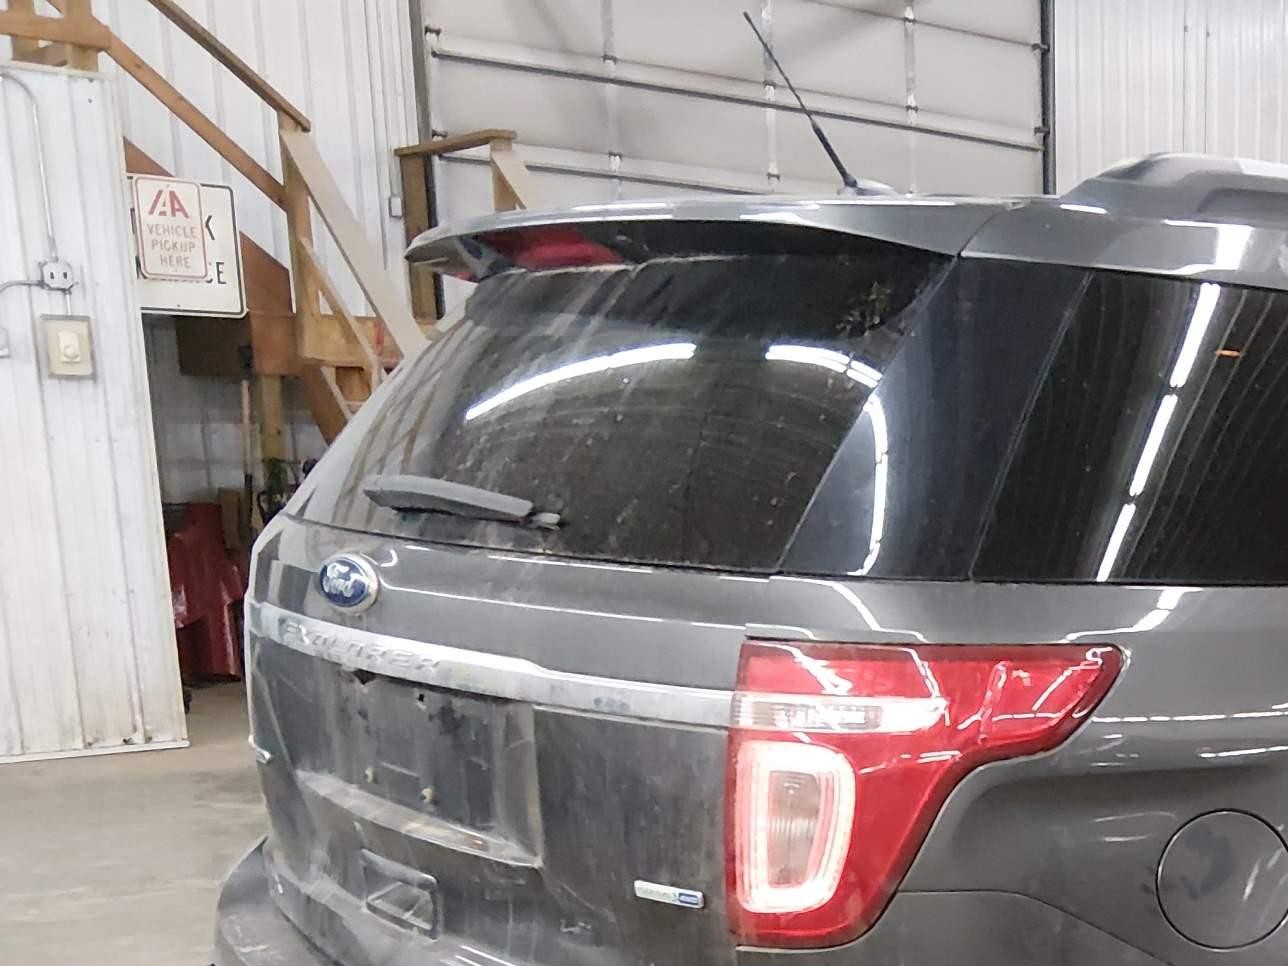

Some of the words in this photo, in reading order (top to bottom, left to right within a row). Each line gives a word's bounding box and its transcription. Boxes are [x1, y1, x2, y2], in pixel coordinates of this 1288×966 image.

[146, 223, 198, 239] VEHICLE
[151, 239, 196, 253] PICKUP
[160, 255, 191, 268] HERE
